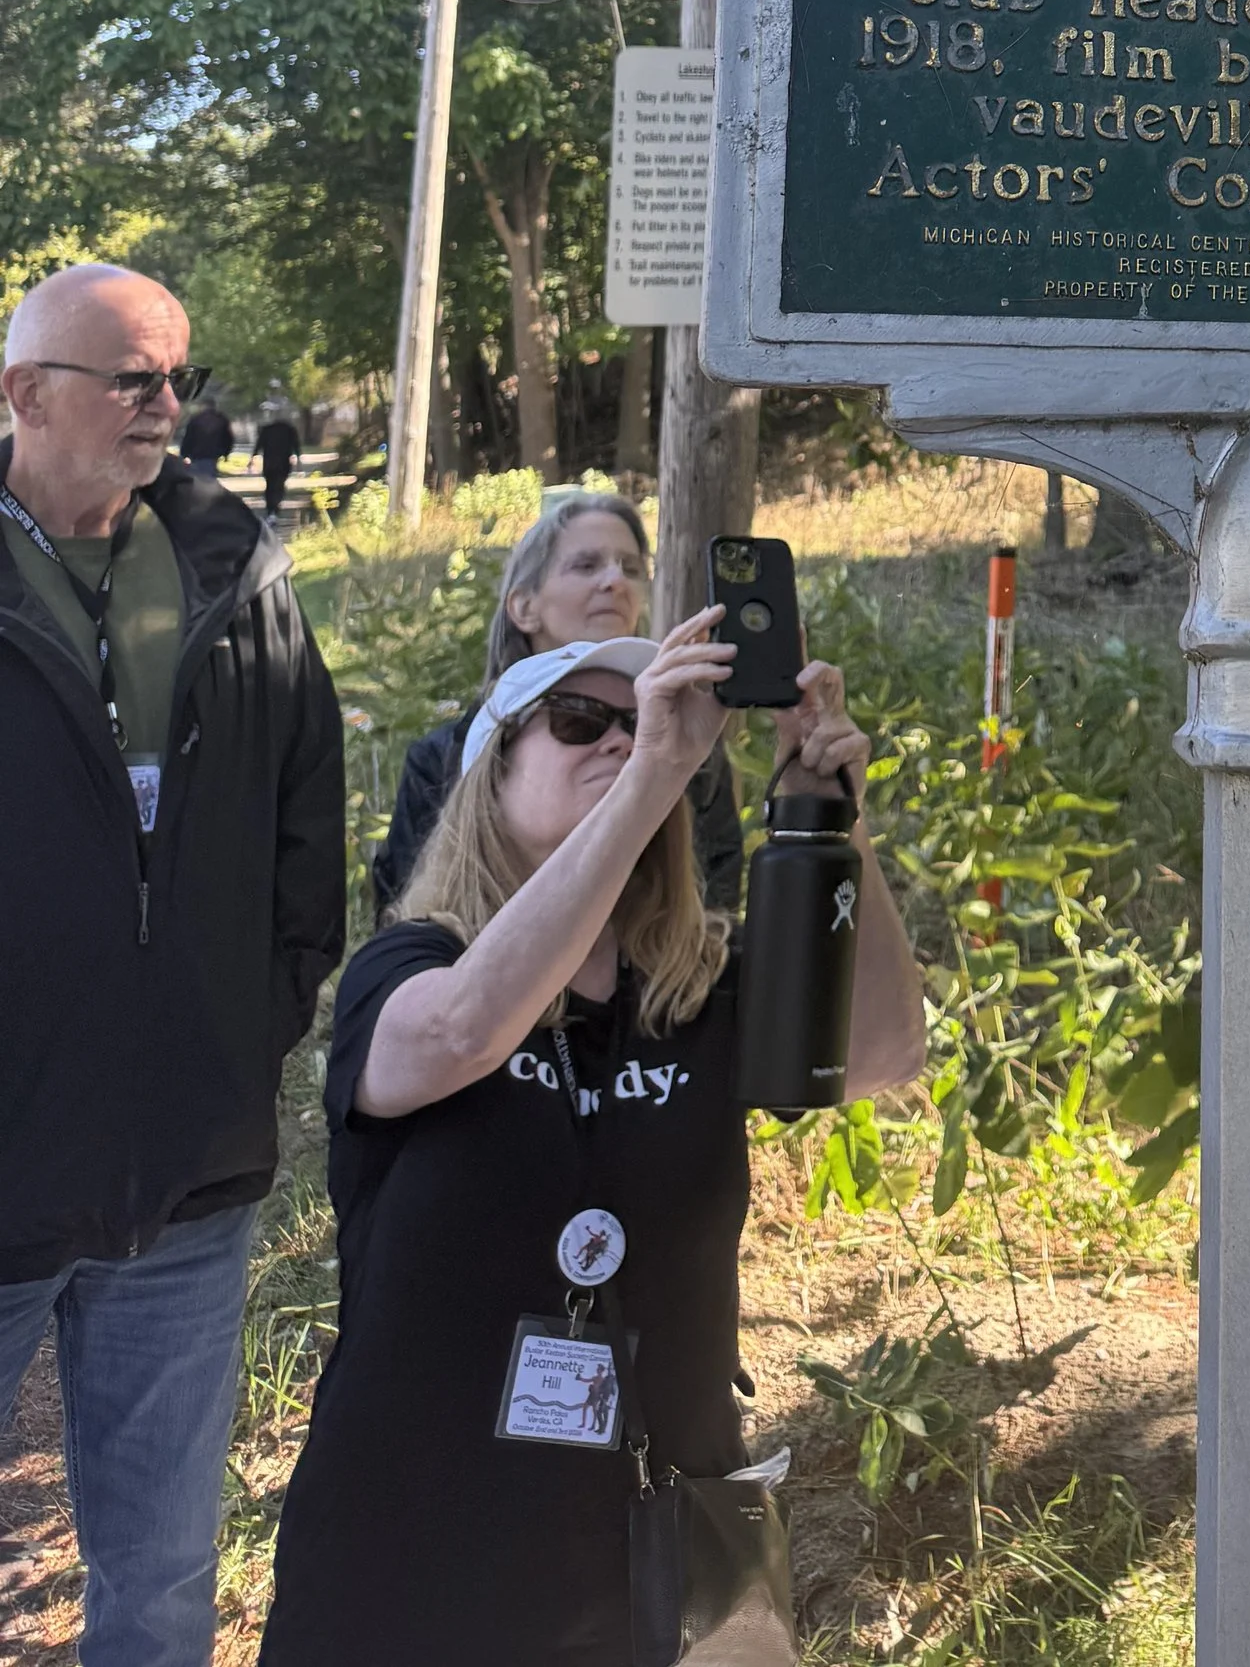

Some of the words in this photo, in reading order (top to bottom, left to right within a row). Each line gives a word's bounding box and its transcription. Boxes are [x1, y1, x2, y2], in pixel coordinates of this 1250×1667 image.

[858, 14, 1005, 76] 1918,
[1053, 26, 1175, 81] film
[678, 62, 714, 75] Lakesho
[867, 143, 1107, 202] Actors'
[924, 227, 1030, 245] MICHIGAN
[1051, 231, 1176, 250] HISTORICAL
[1044, 281, 1153, 299] PROPERTY
[1171, 284, 1195, 300] OF
[1208, 285, 1248, 303] THE
[524, 1354, 585, 1374] Jeannette
[542, 1375, 561, 1390] Hill
